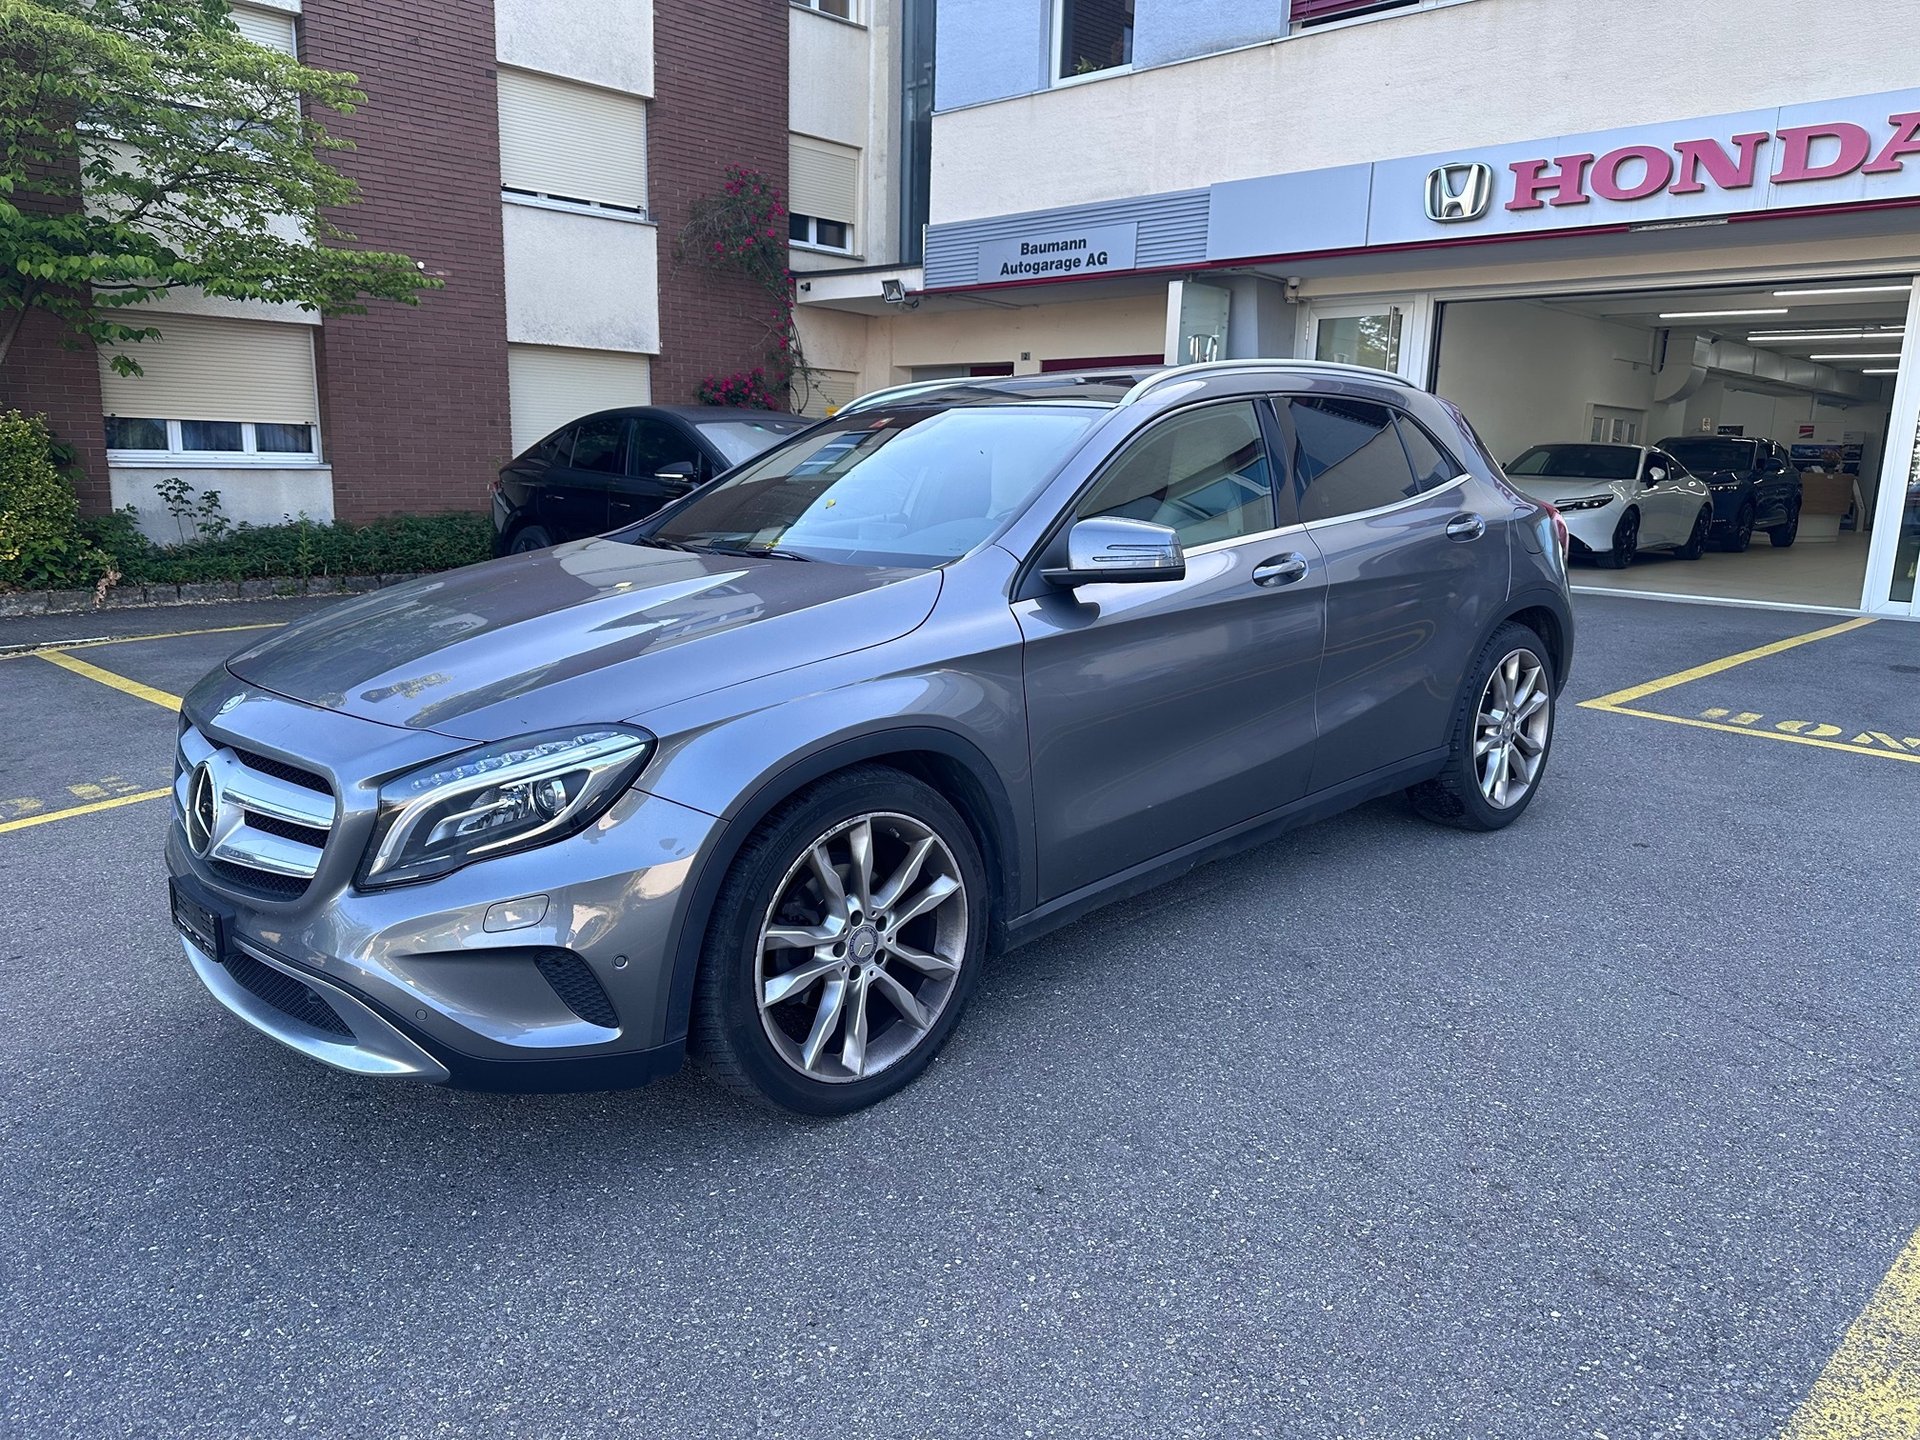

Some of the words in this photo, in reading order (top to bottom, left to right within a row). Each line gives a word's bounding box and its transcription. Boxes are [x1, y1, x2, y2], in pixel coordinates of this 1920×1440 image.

[1505, 111, 1920, 211] HONDA
[1021, 238, 1086, 256] Baumann
[1000, 257, 1082, 275] Autogarage
[1086, 251, 1108, 267] AG
